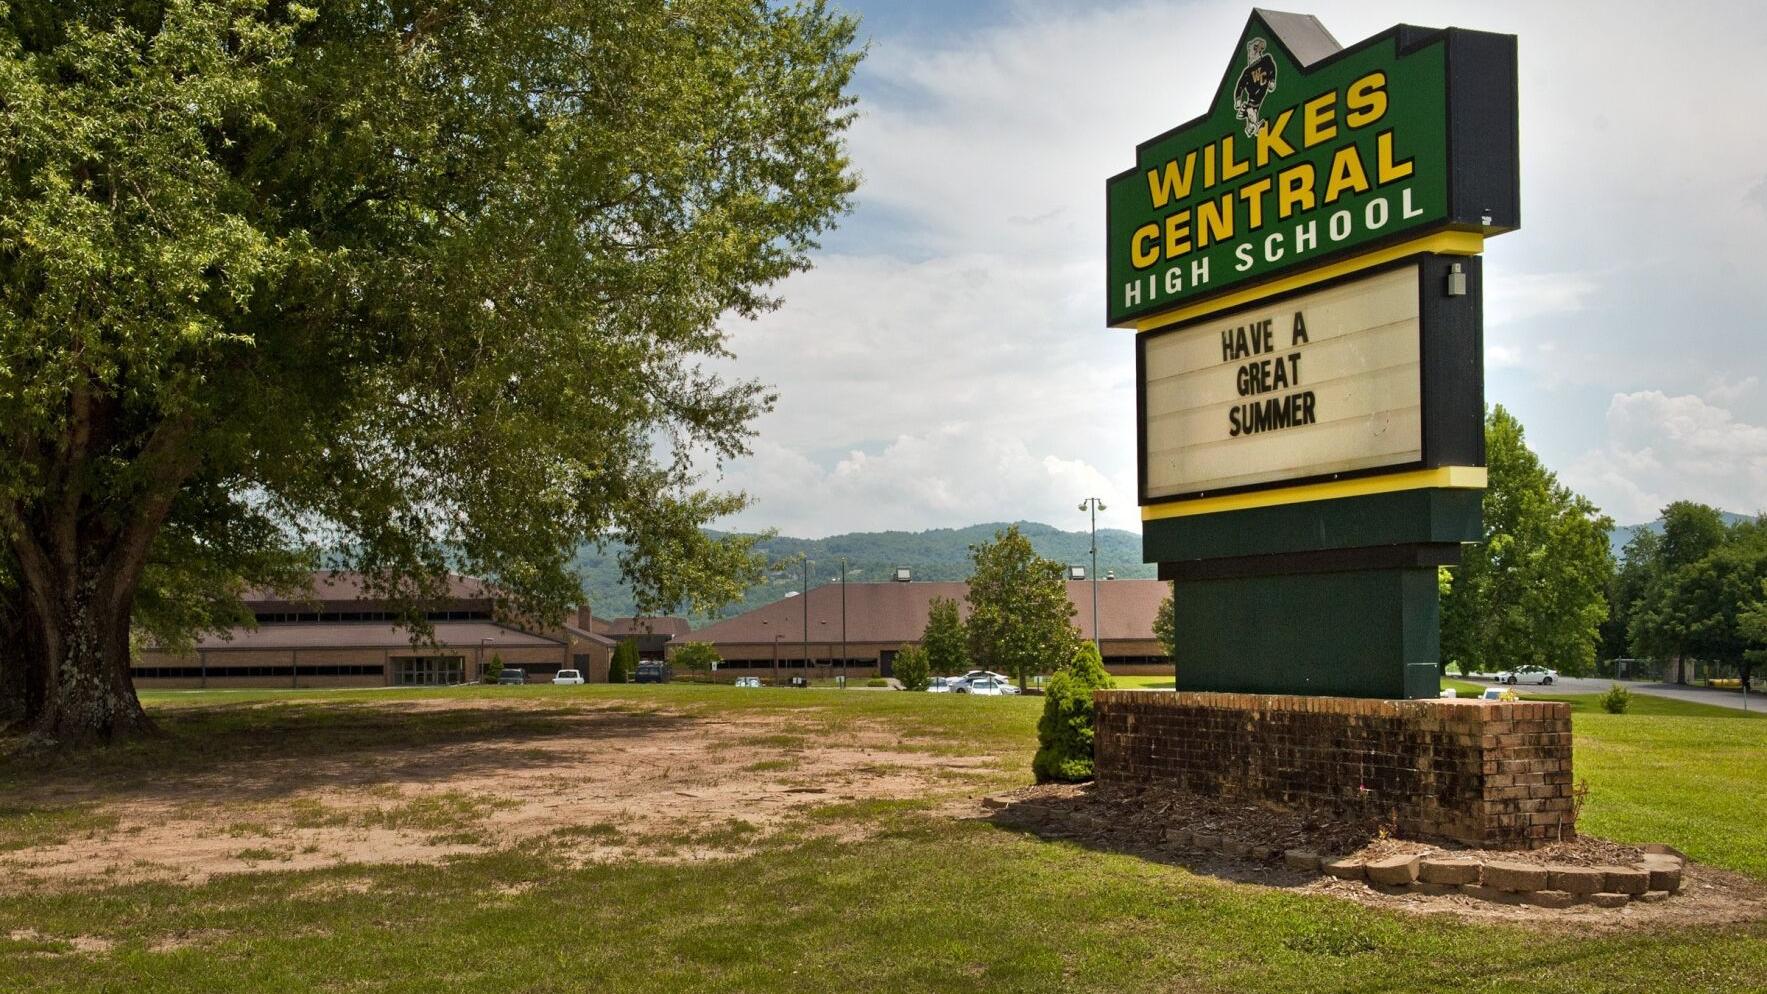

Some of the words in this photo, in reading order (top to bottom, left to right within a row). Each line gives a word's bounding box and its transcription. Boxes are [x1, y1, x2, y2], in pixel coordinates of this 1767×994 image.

[1147, 71, 1388, 209] WILKES
[1131, 131, 1414, 269] CENTRAL
[1125, 257, 1210, 307] HIGH
[1235, 188, 1424, 271] SCHOOL
[1222, 318, 1274, 362] HAVE
[1292, 311, 1309, 346] A
[1236, 353, 1301, 397] GREAT
[1229, 391, 1316, 437] SUMMER
